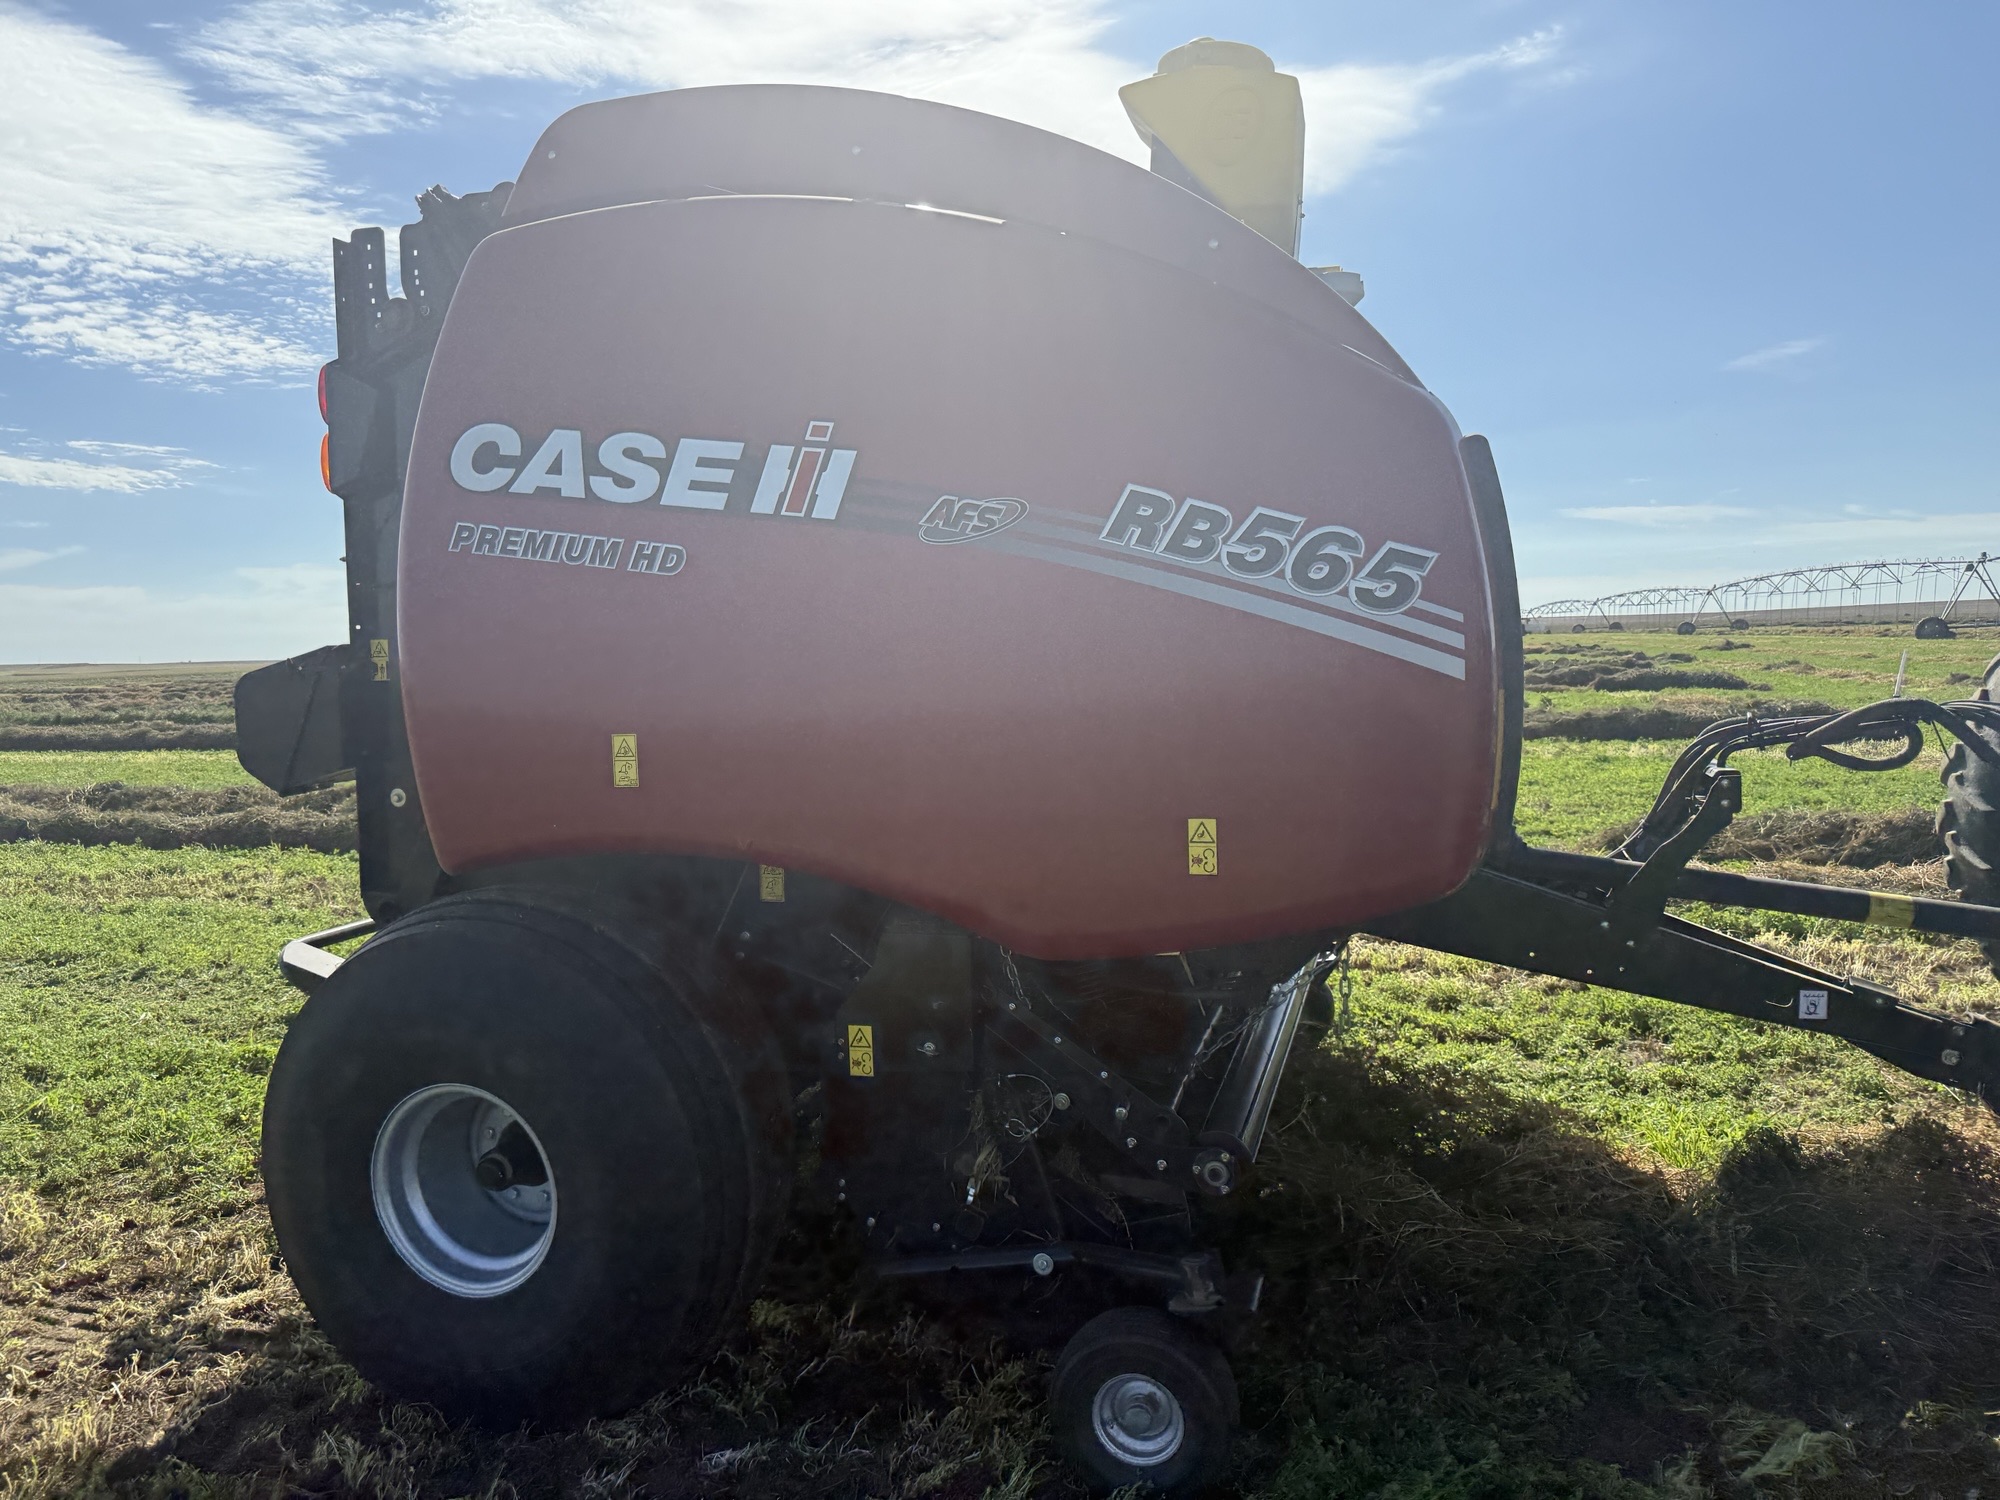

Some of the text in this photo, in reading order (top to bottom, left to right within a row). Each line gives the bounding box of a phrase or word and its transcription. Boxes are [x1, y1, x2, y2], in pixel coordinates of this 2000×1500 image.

[450, 423, 745, 510] CASE
[448, 522, 688, 576] PREMIUM HD
[919, 495, 1006, 535] AFS
[1100, 483, 1440, 616] RB565
